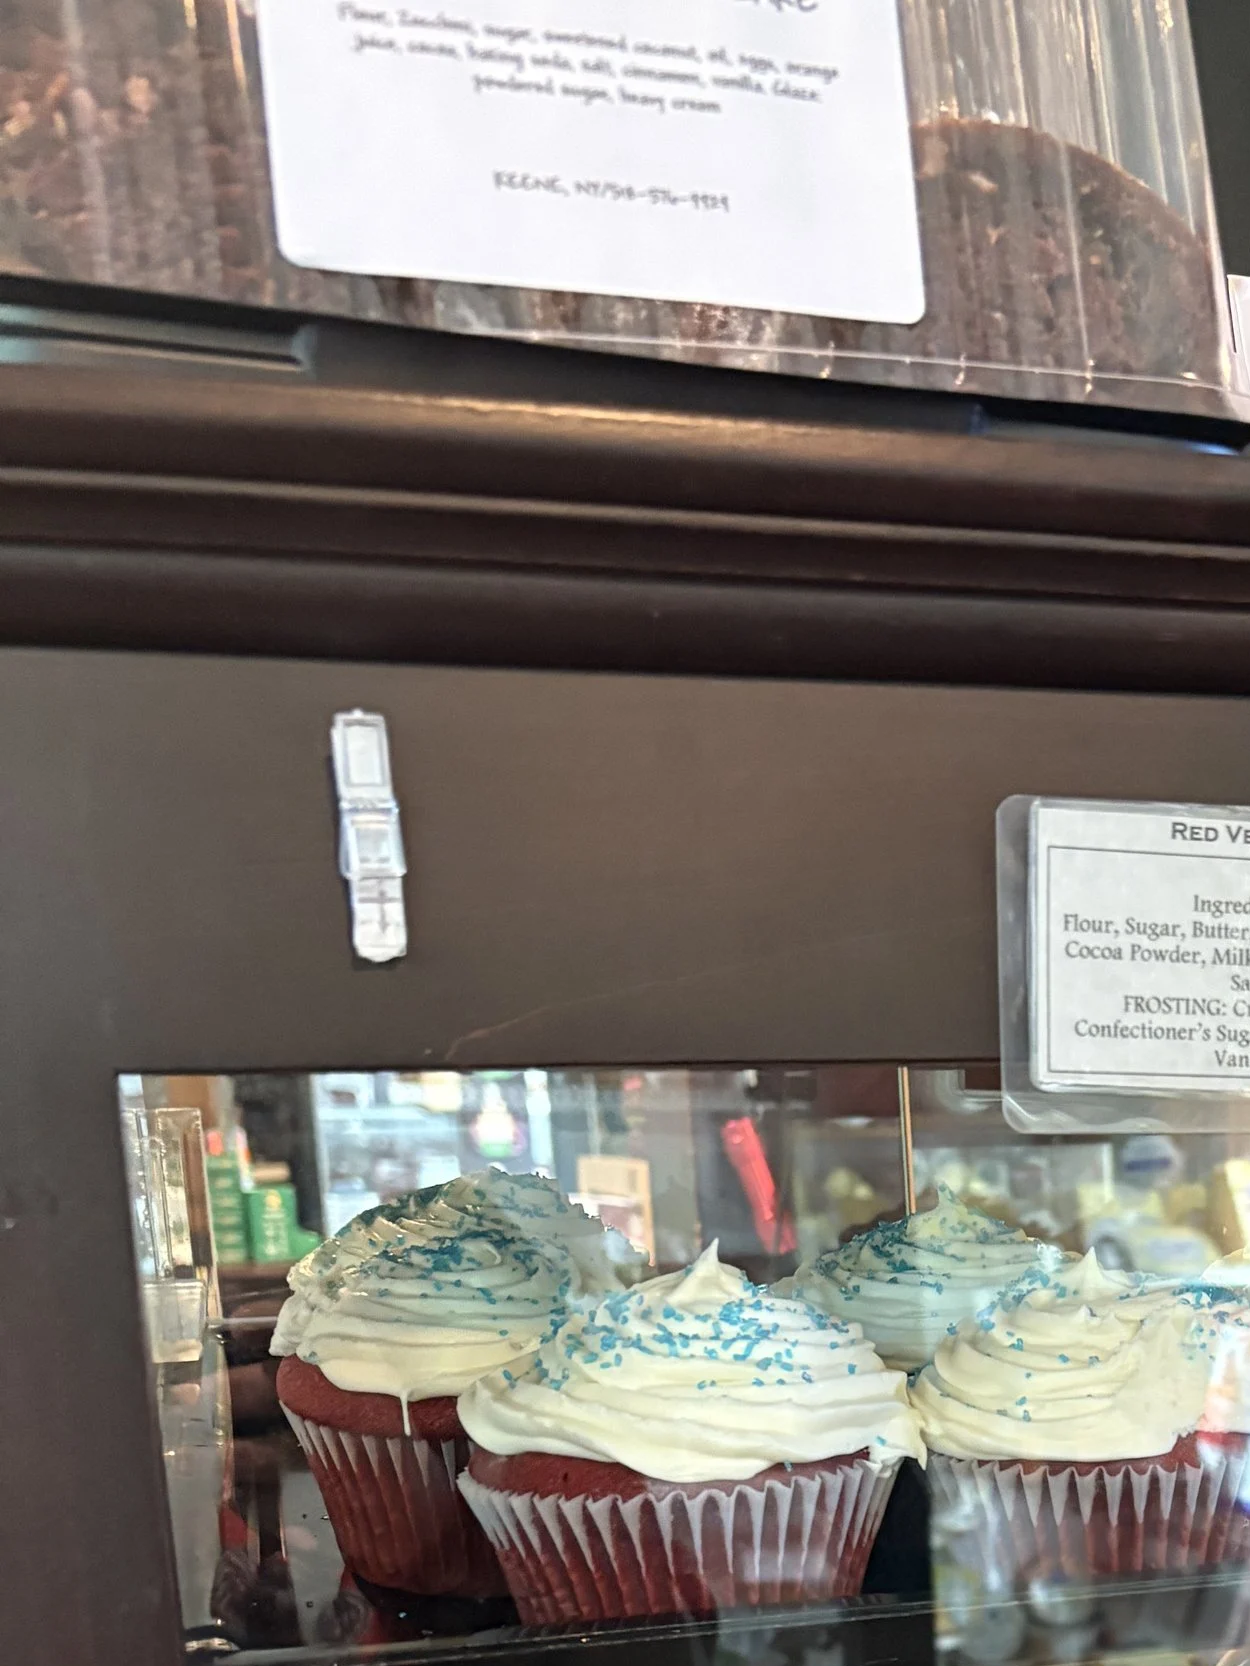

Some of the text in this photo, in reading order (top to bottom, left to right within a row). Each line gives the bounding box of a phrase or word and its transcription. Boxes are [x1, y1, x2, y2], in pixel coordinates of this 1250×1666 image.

[1171, 822, 1219, 843] RED
[1063, 914, 1120, 936] Flour,
[1125, 917, 1185, 941] Sugar,
[1064, 941, 1123, 962] Cocoa
[1130, 943, 1206, 968] Powder,
[1123, 995, 1227, 1018] FROSTING:
